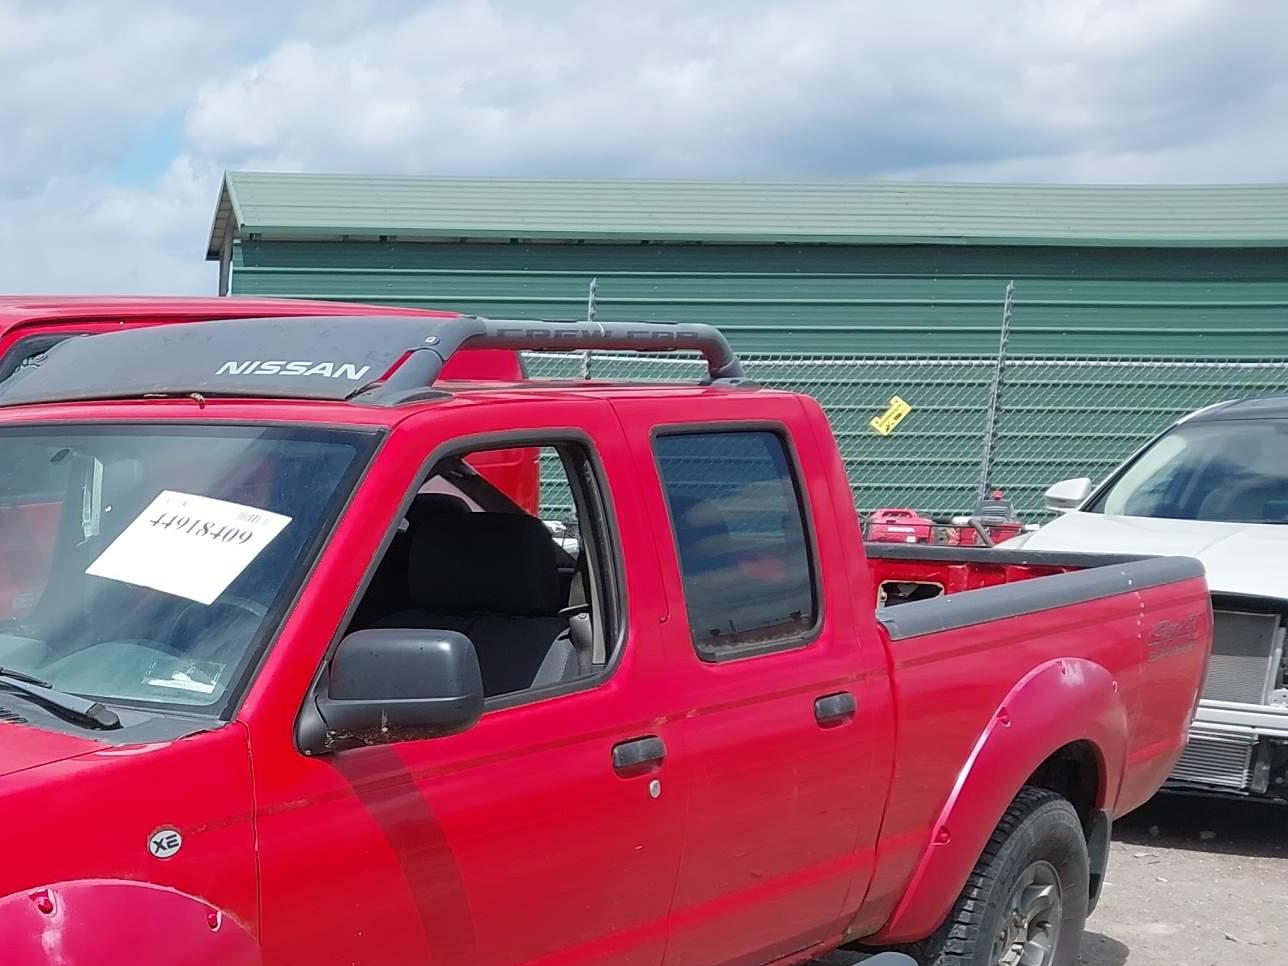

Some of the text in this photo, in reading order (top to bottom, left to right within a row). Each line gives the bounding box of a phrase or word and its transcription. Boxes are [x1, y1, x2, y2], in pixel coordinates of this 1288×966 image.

[215, 360, 371, 380] NISSAN
[149, 512, 253, 545] 44918409
[152, 833, 180, 854] XE
